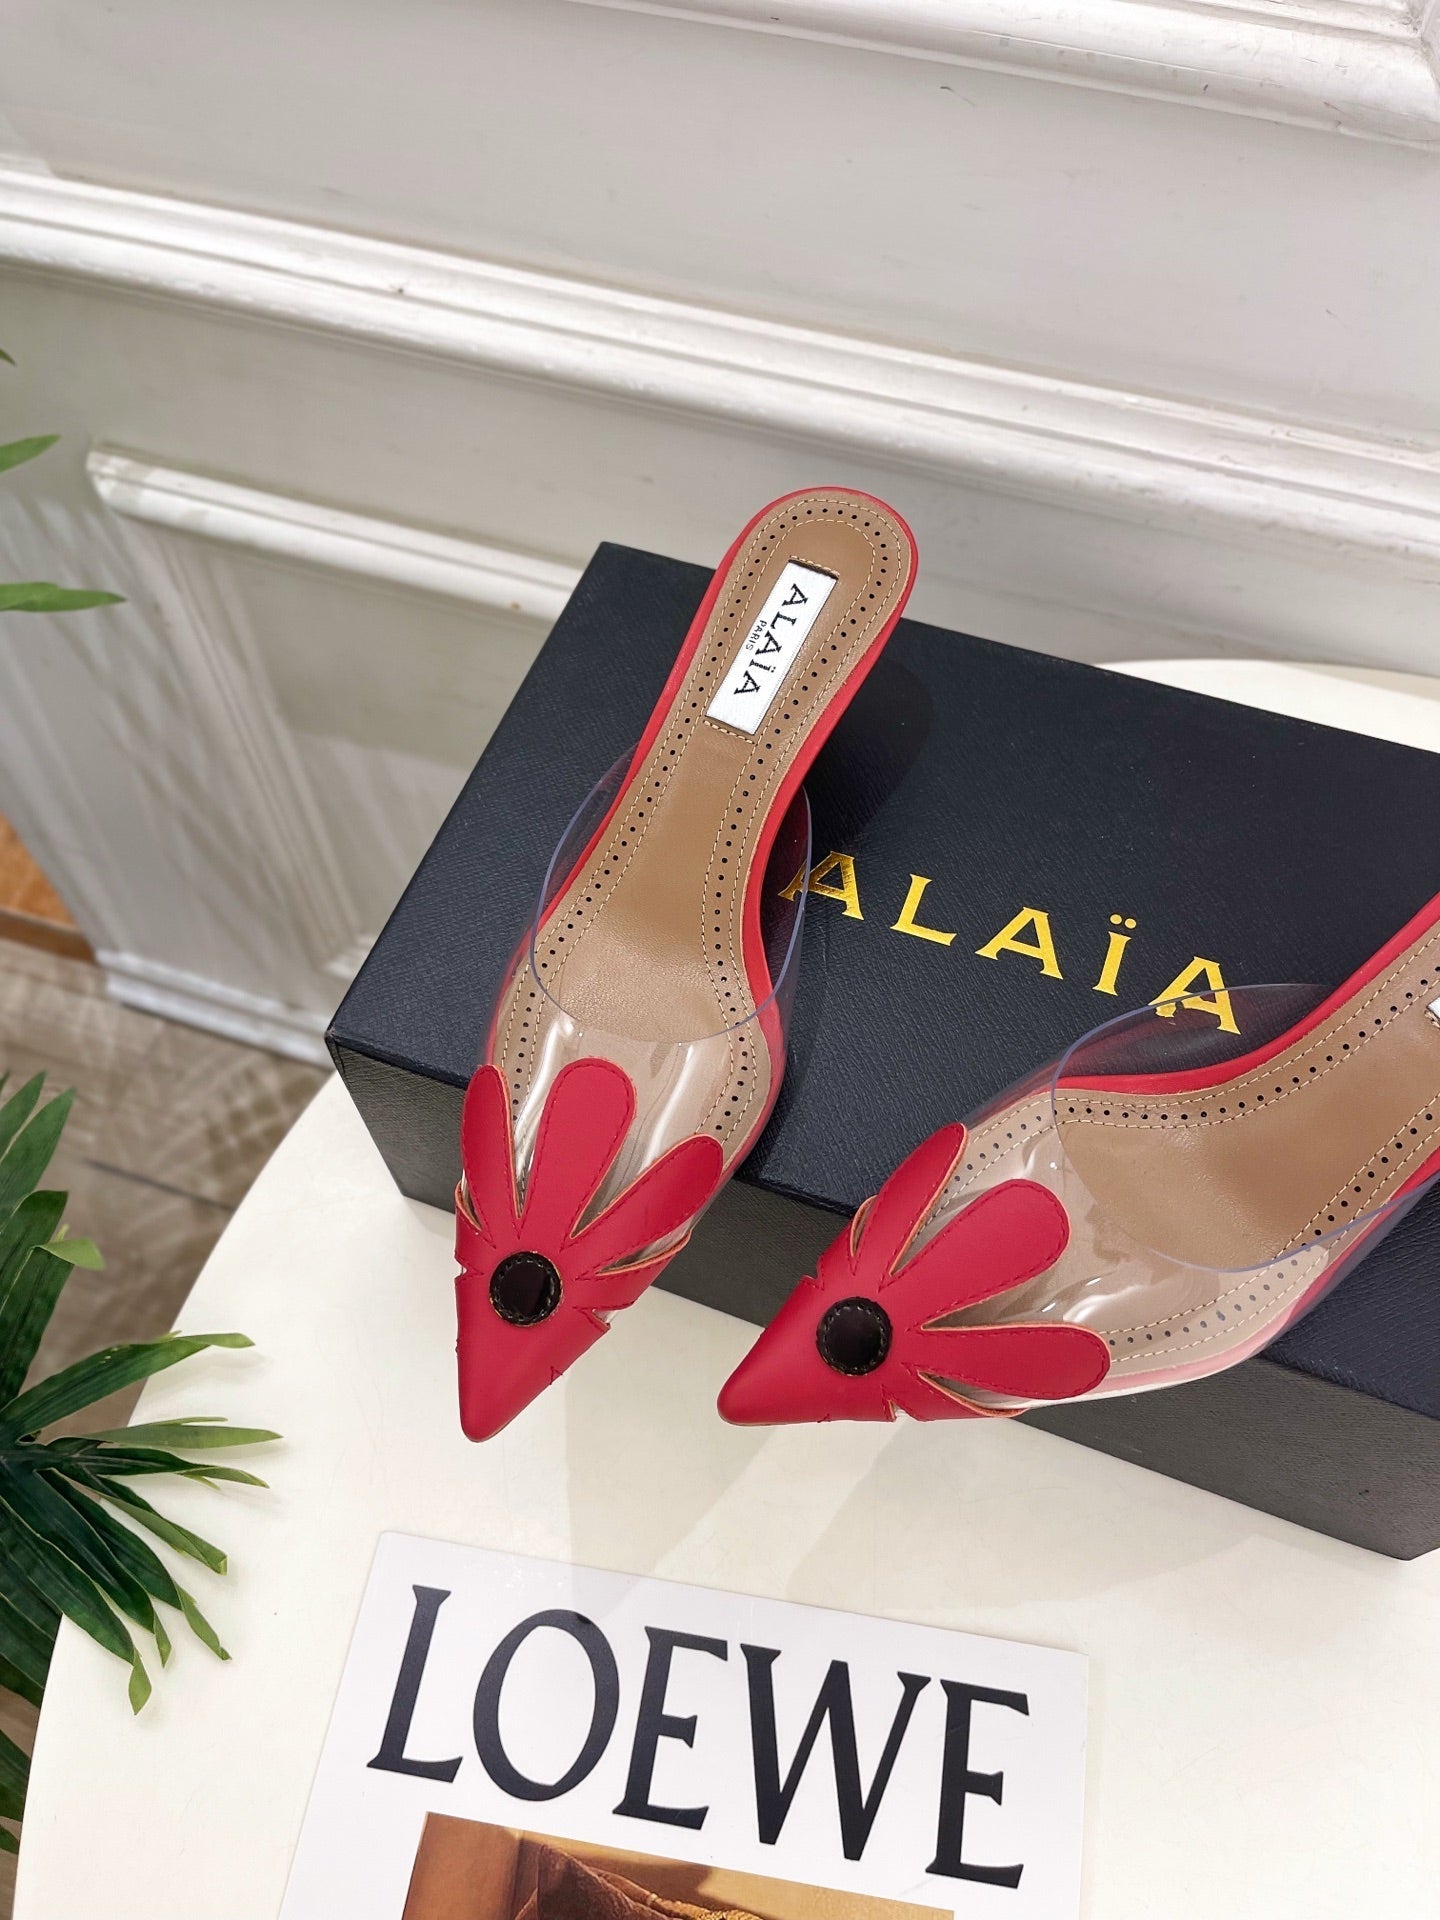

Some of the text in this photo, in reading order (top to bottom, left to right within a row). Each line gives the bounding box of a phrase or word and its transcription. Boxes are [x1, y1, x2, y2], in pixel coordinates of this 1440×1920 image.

[733, 583, 809, 695] ALAÏA
[745, 619, 768, 651] PARIS
[777, 850, 1242, 1035] ALAÏA
[366, 1583, 1030, 1890] LOEWE
